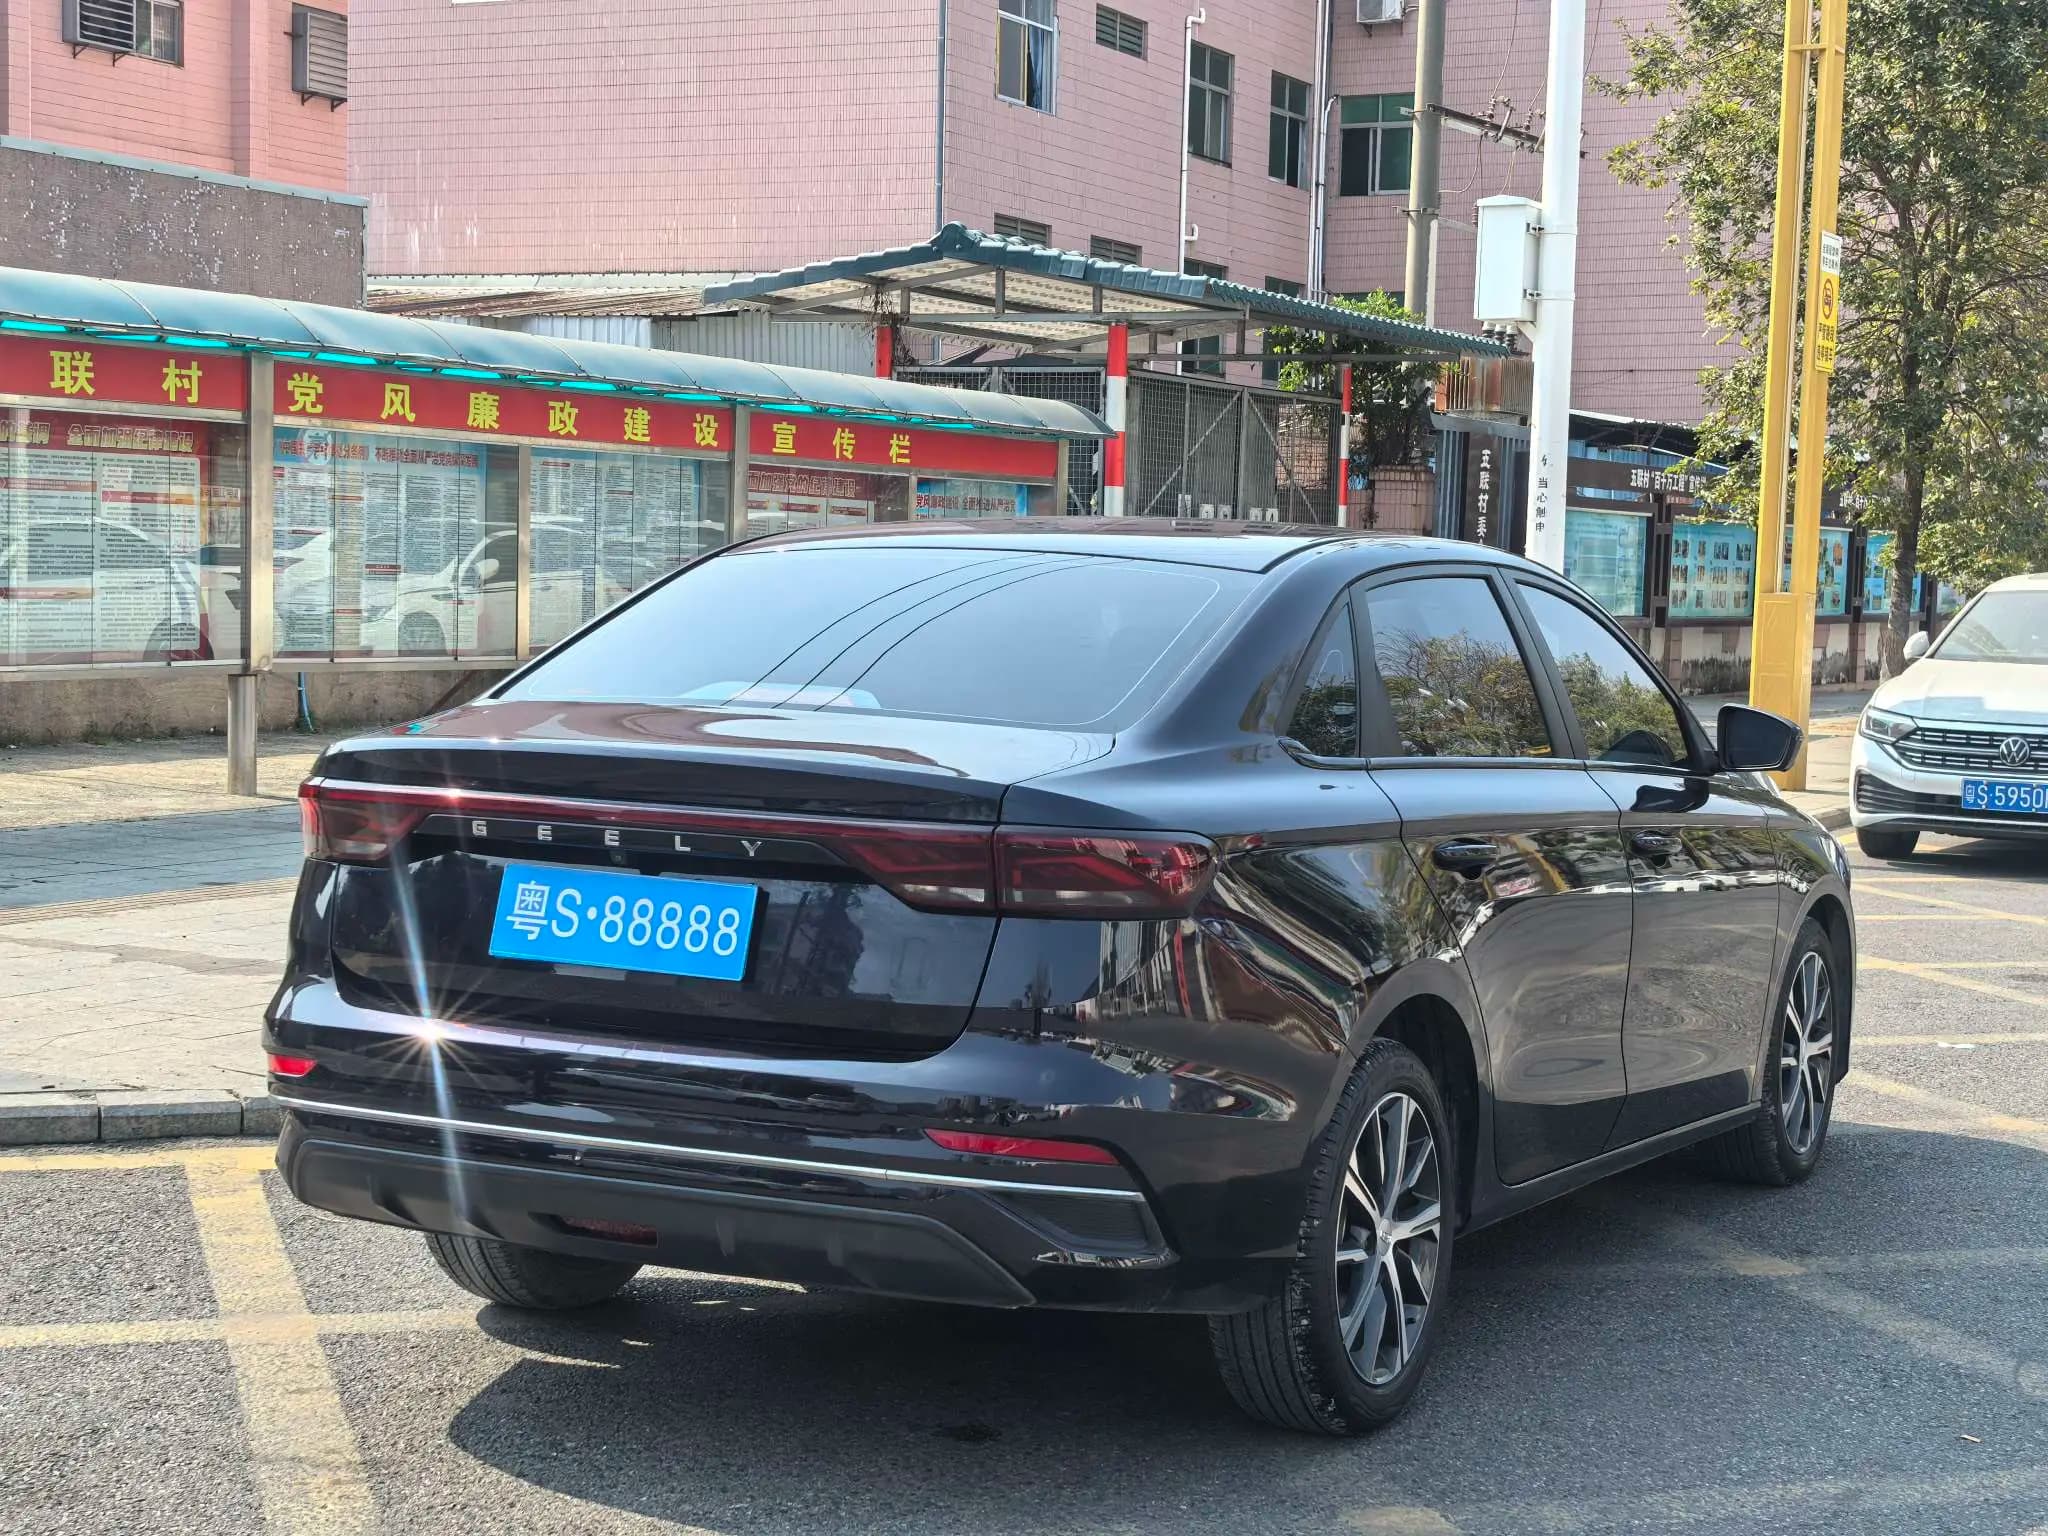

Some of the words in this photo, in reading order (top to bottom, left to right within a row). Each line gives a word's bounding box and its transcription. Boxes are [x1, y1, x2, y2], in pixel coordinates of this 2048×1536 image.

[50, 351, 202, 404] 联村
[287, 372, 717, 446] 党风廉政建设
[773, 423, 910, 464] 宣传栏
[472, 820, 762, 857] GEELY
